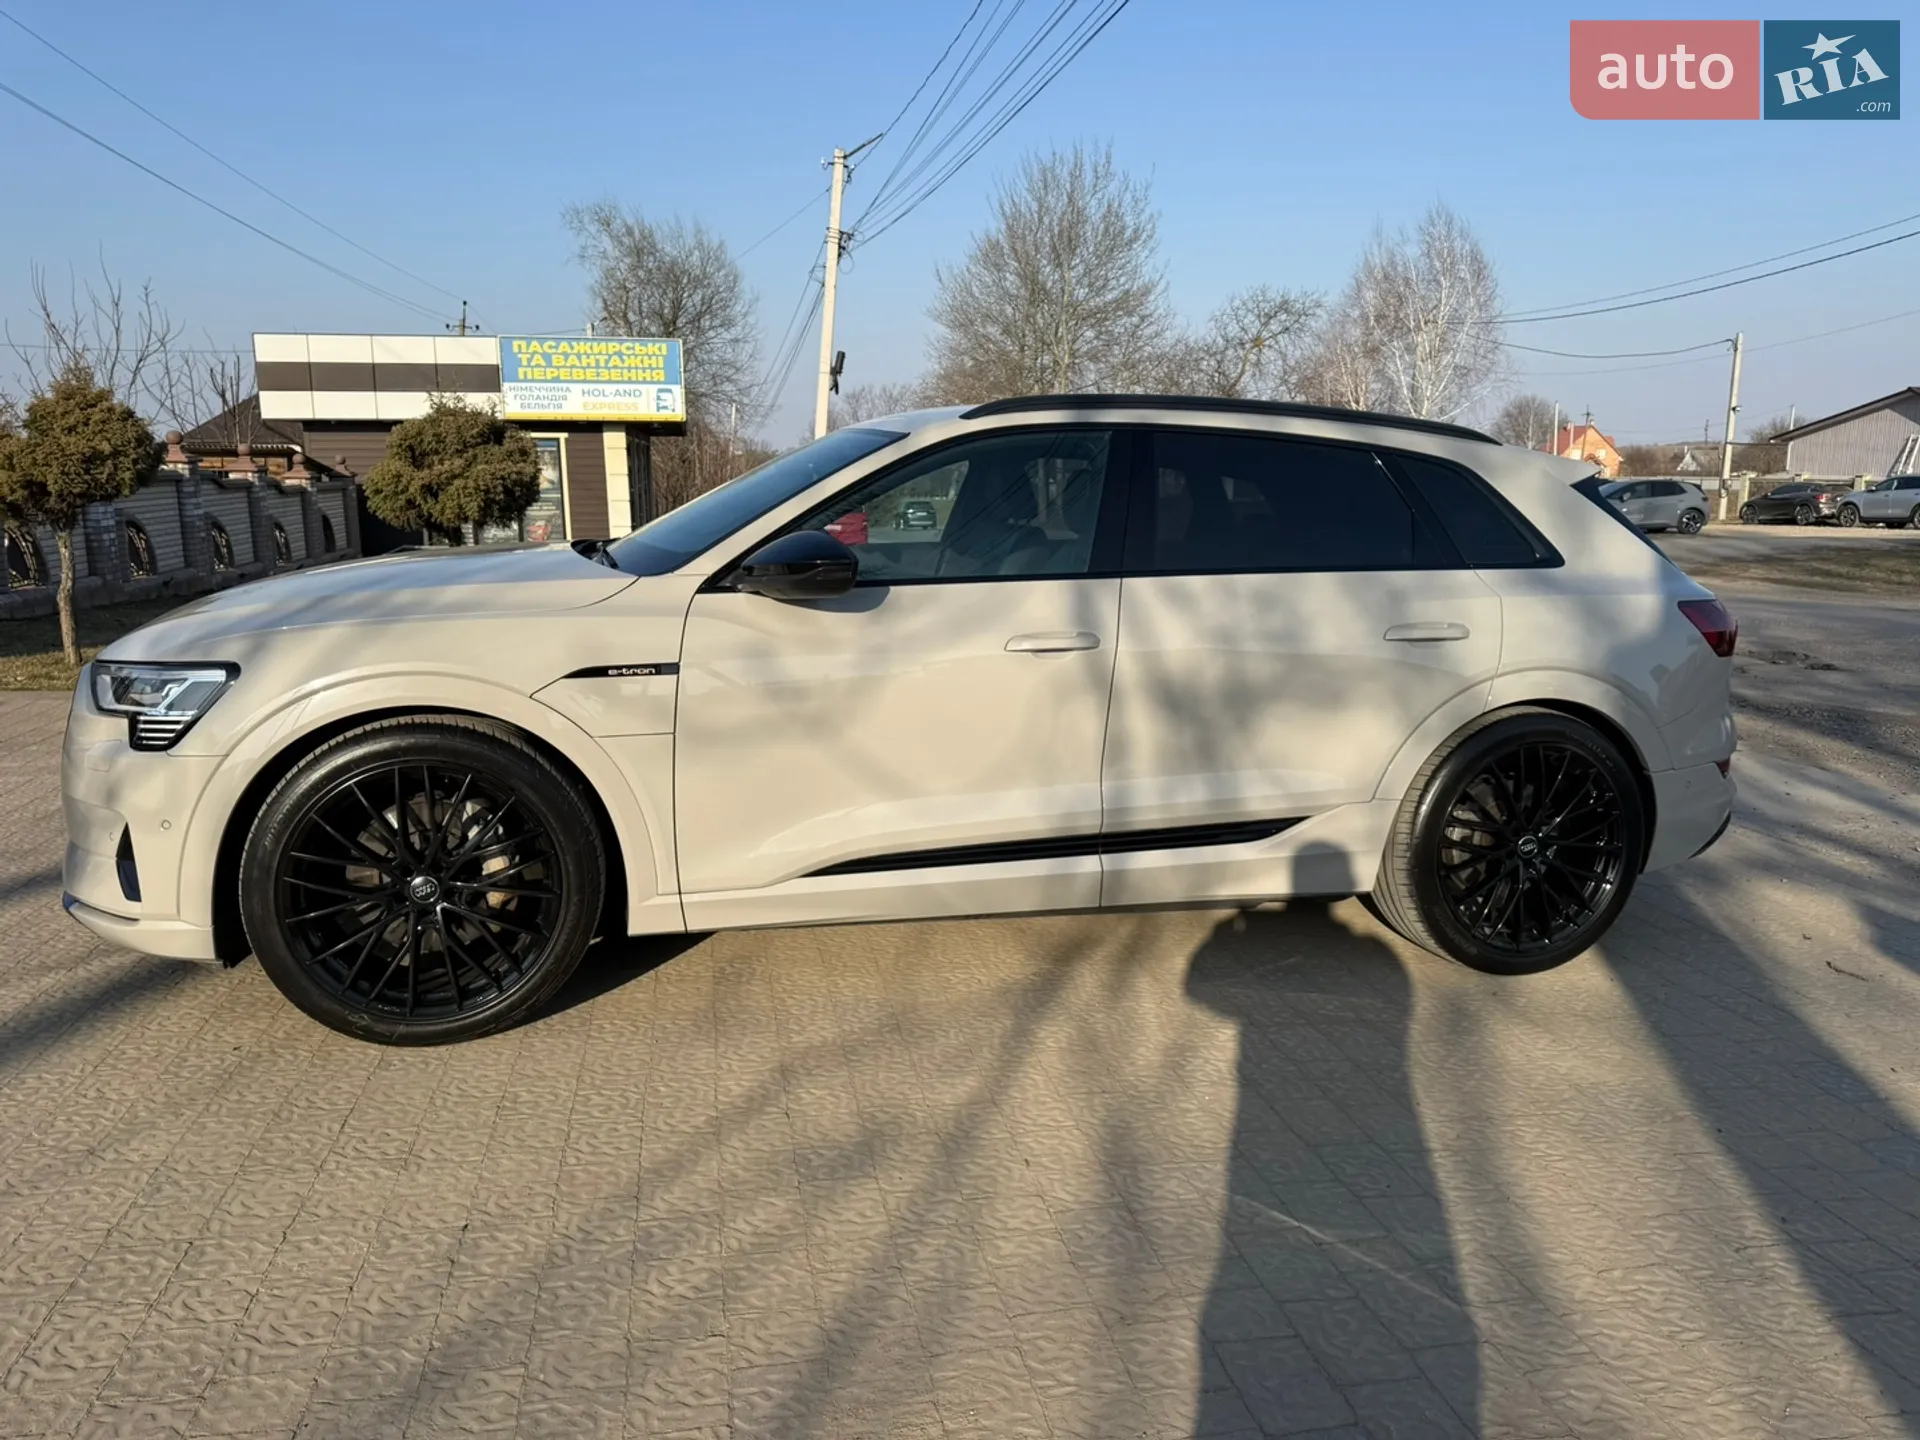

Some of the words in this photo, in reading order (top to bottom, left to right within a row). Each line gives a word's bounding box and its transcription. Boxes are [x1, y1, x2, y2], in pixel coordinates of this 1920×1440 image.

[512, 340, 667, 355] ПАСАЖИРСЬКІ
[518, 353, 546, 367] ТА
[551, 354, 664, 368] ВАНТАЖНІ
[518, 367, 665, 381] ПЕРЕВЕЗЕННЯ
[508, 385, 572, 393] НІМЕЧЧИНА
[513, 393, 568, 402] ГОЛАНДІЯ
[520, 402, 563, 410] БЕЛЬГІЯ
[582, 401, 639, 411] EXPRESS
[607, 667, 656, 676] e-tron
